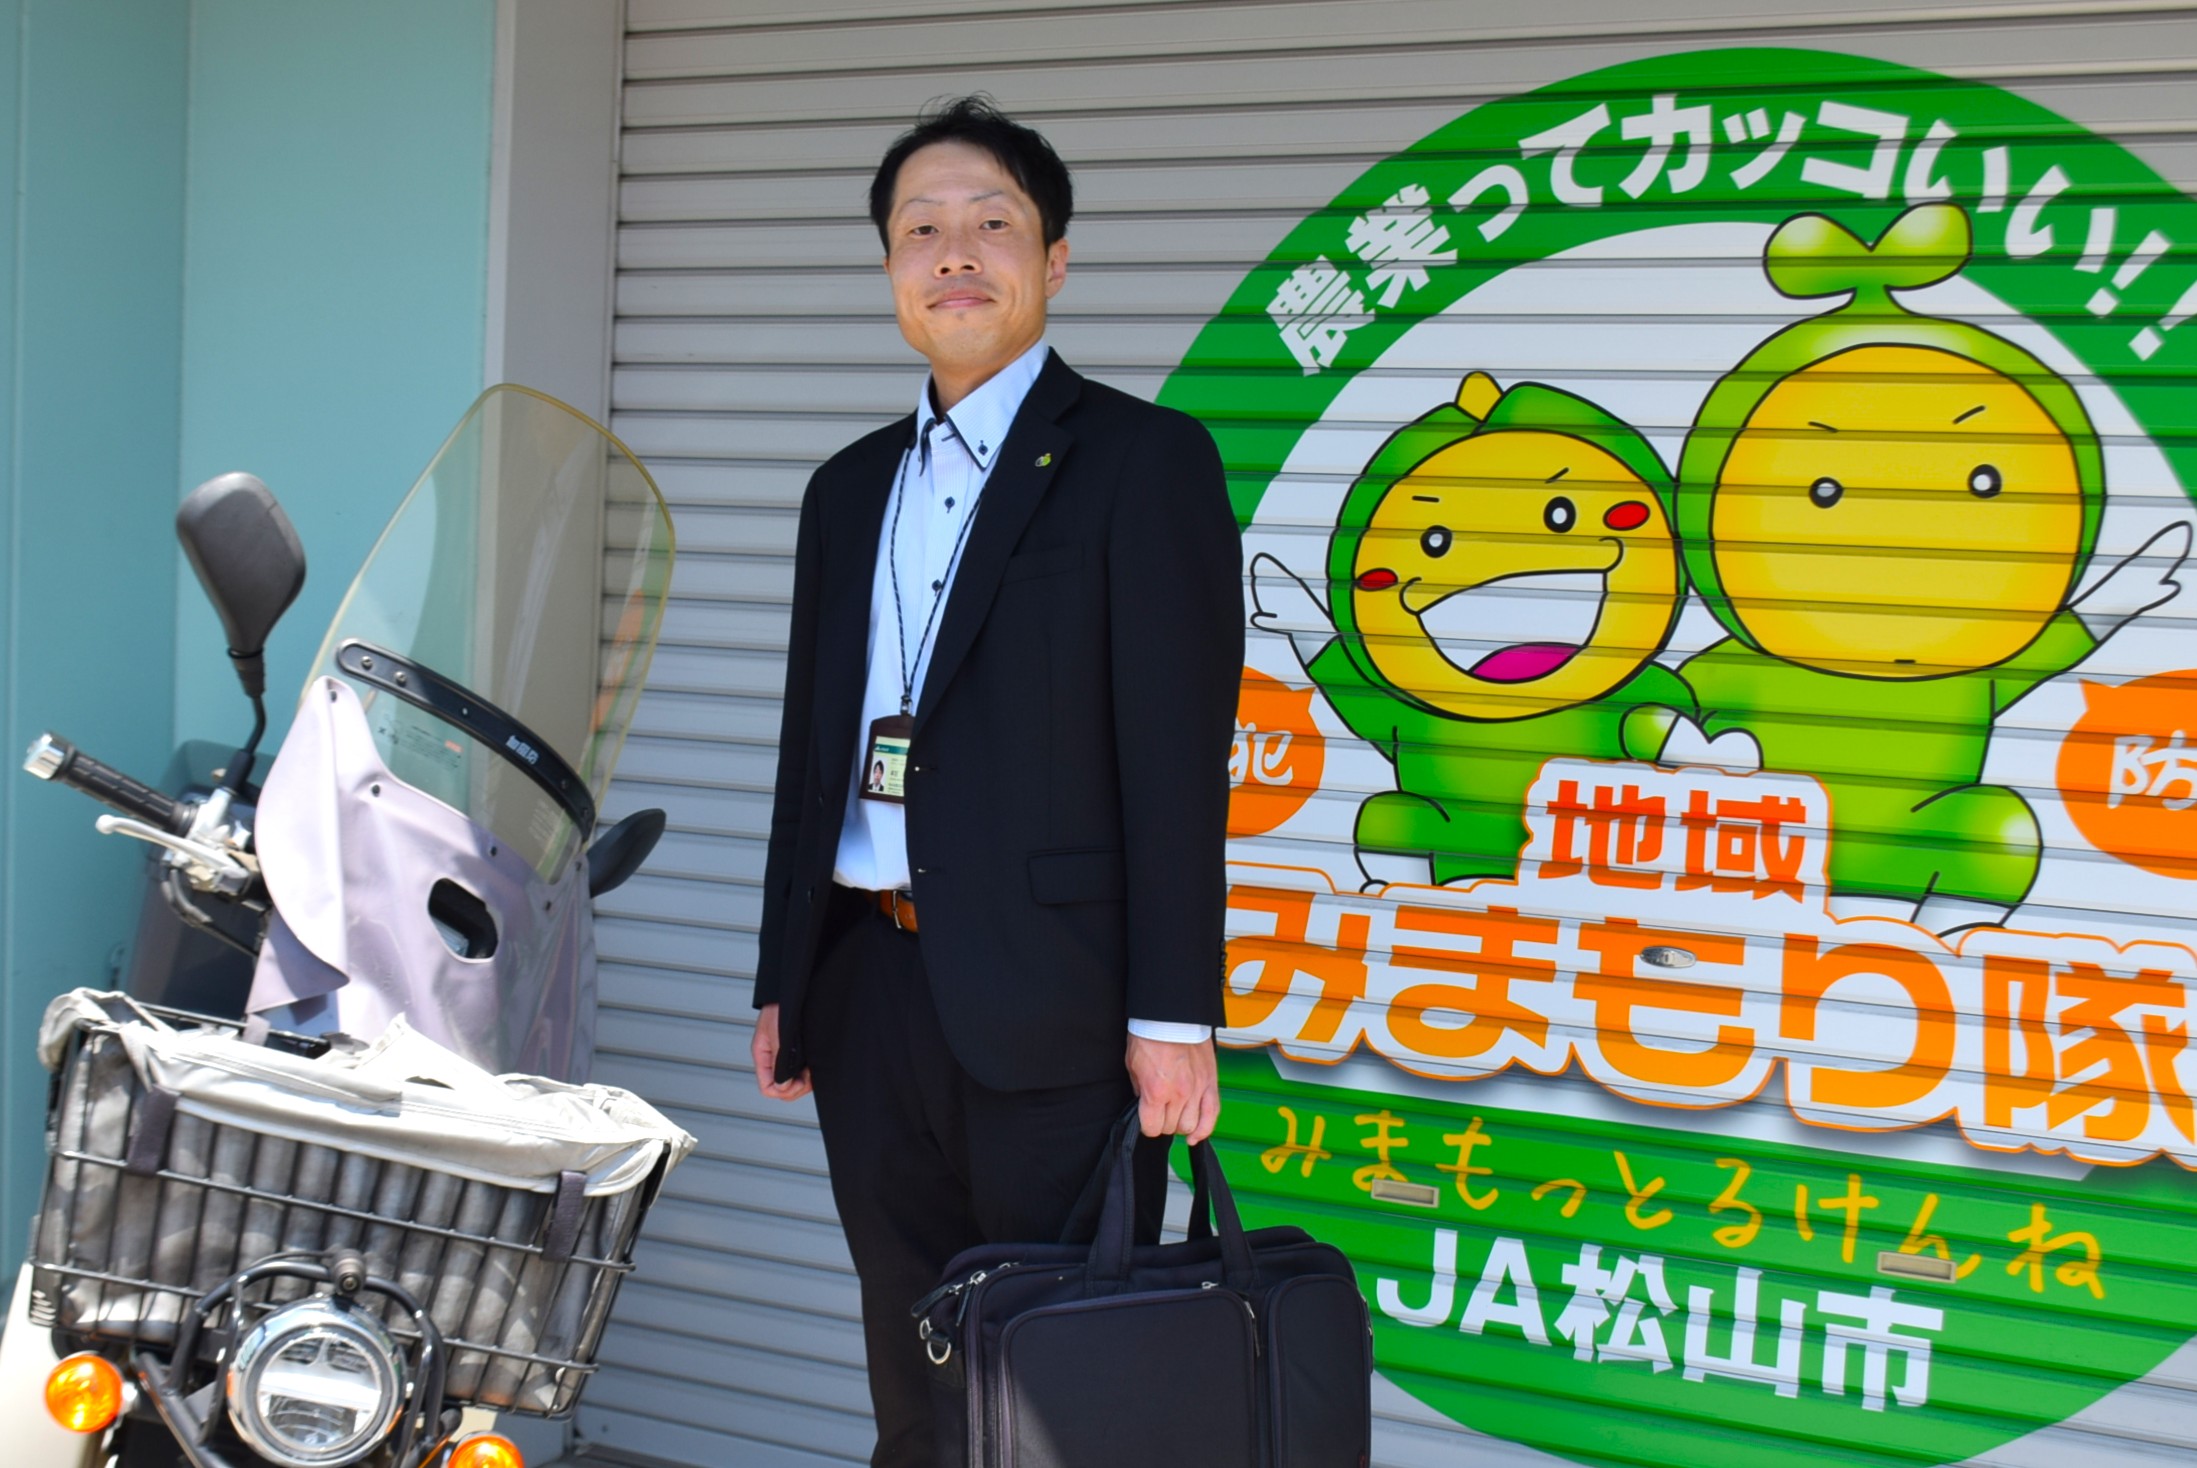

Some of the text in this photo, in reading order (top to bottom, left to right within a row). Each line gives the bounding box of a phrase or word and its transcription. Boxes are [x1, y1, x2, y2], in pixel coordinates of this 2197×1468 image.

[1537, 780, 1807, 904] 地域
[2107, 730, 2197, 811] 防
[1225, 884, 2196, 1146] みまもり隊
[1260, 1106, 2105, 1300] みまもっとるけんね
[1376, 1228, 1944, 1412] JA松山市
